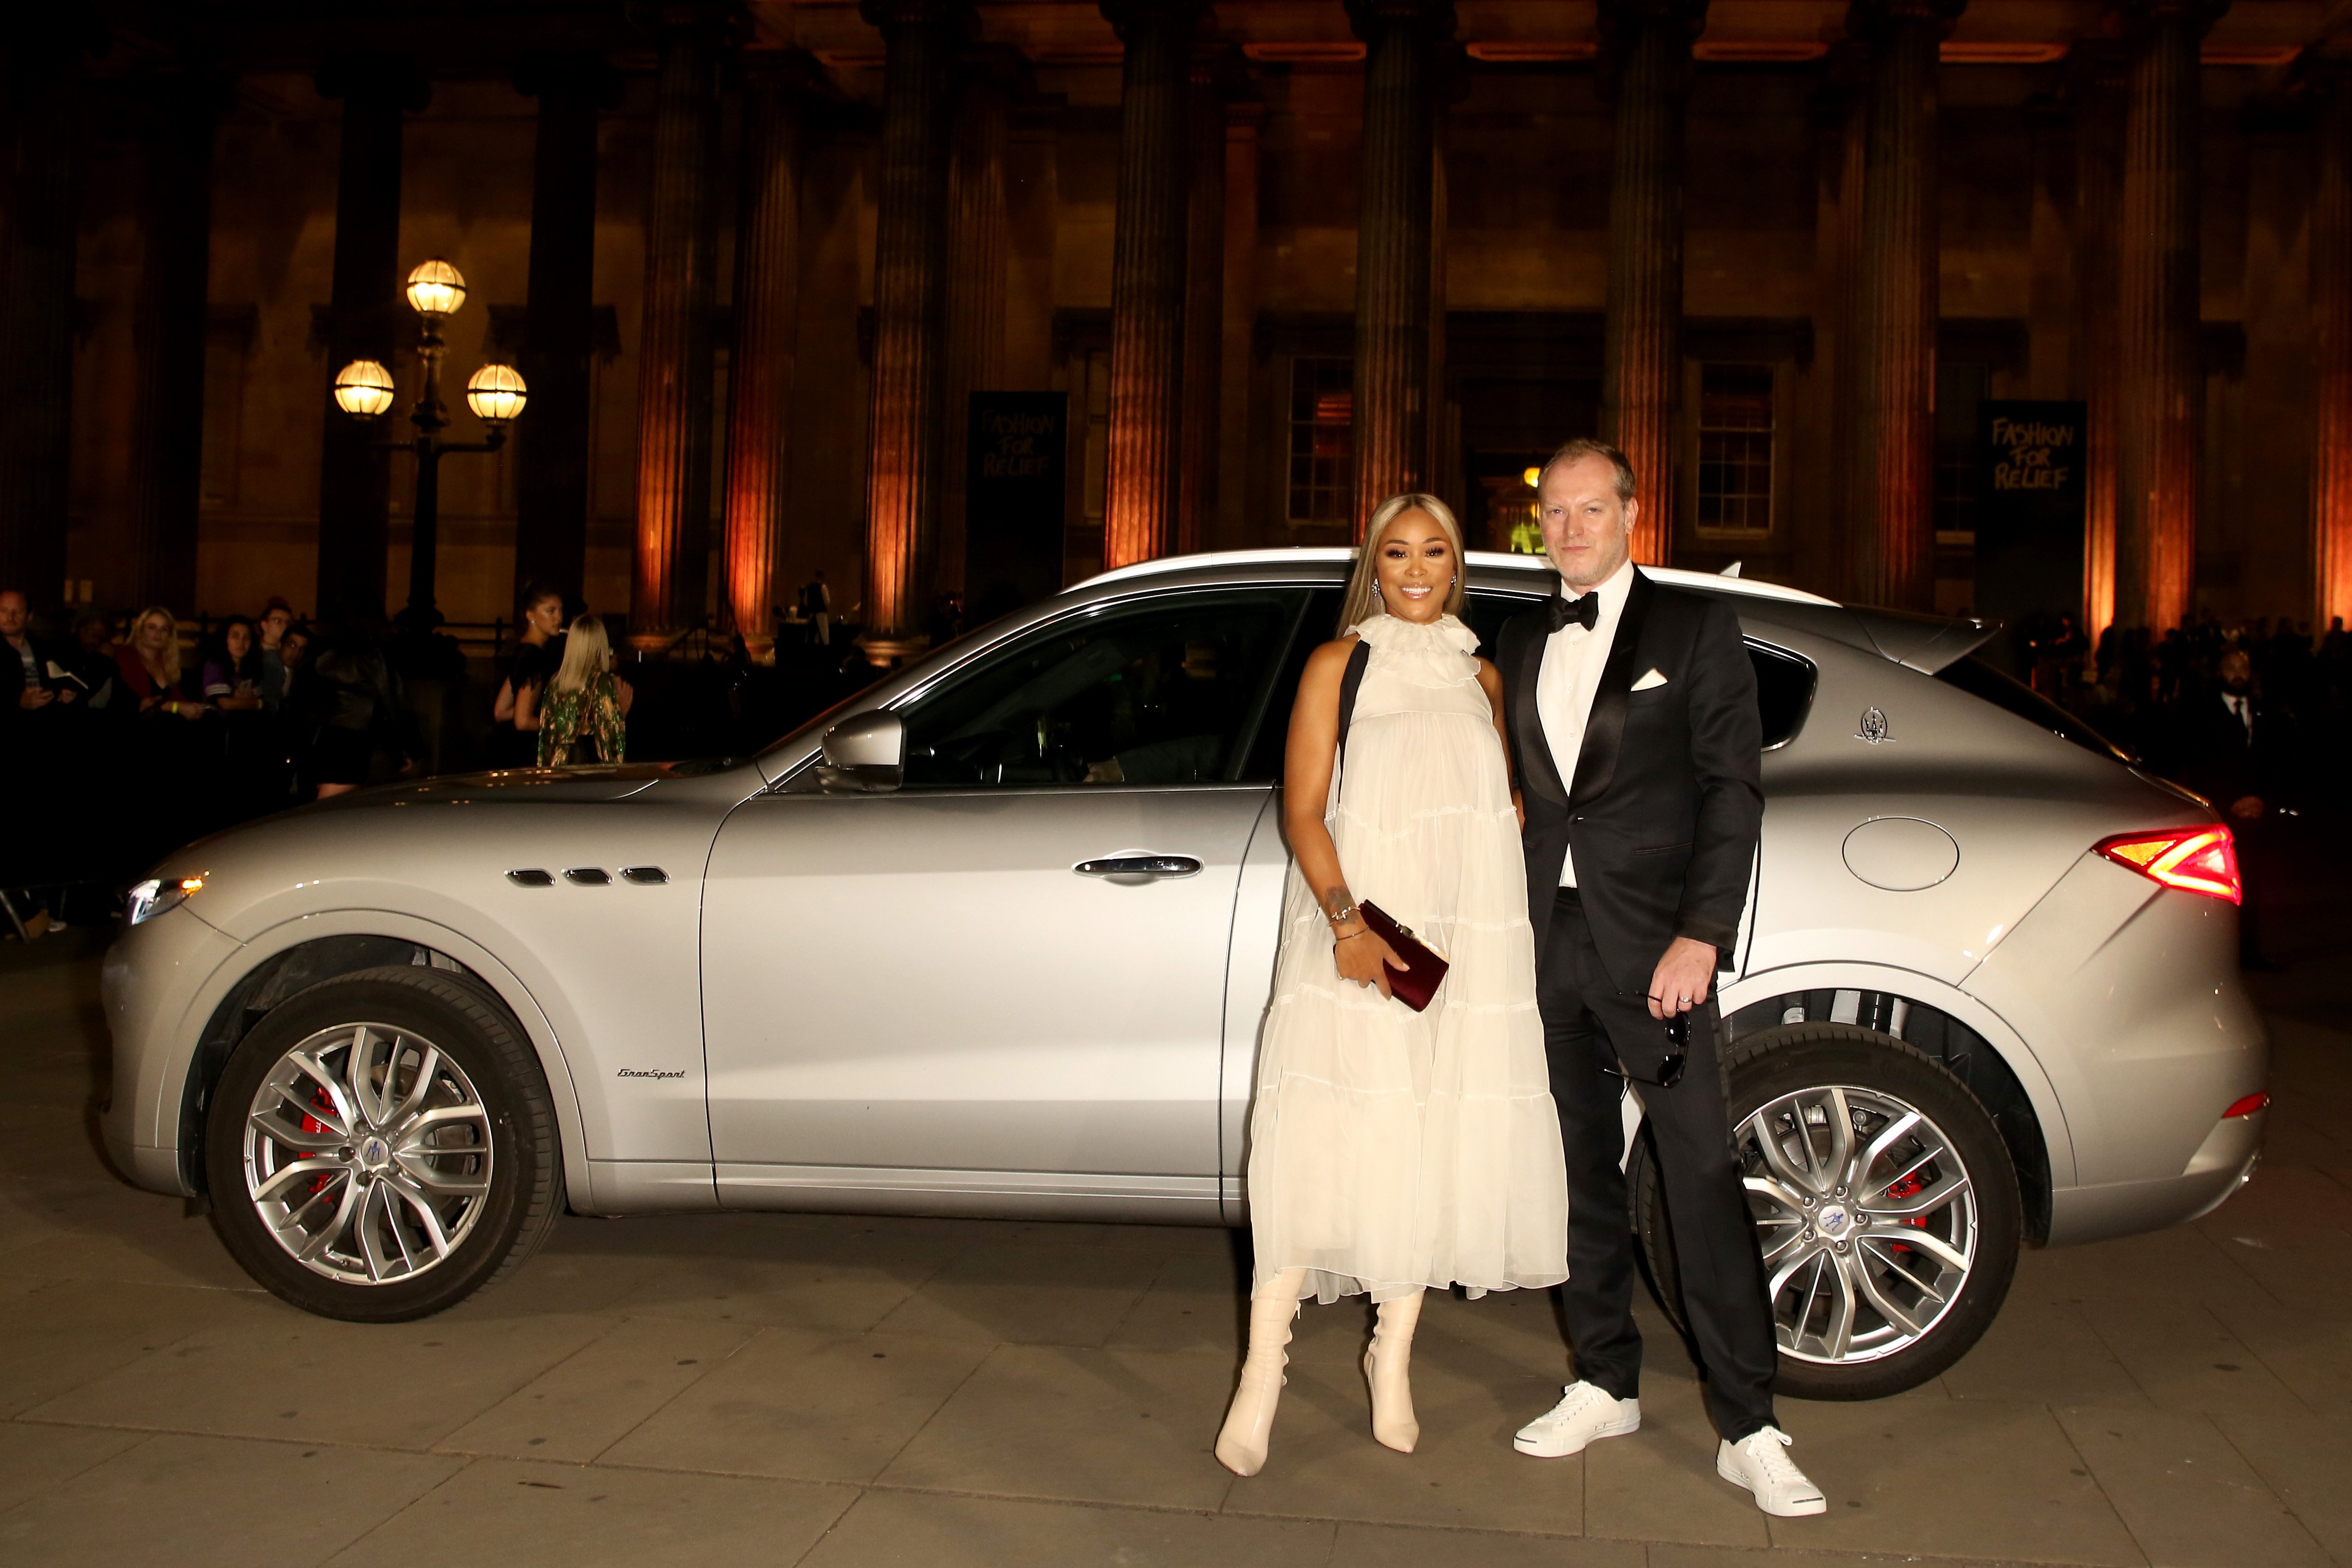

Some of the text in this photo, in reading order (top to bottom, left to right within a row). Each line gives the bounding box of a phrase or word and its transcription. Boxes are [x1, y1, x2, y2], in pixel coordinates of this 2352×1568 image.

[981, 408, 1056, 436] FASHION
[1992, 416, 2074, 446] FASHION
[997, 435, 1034, 455] FOR
[2009, 445, 2051, 467] FOR
[983, 451, 1050, 478] RELIEF
[1993, 461, 2070, 491] RELIEF
[618, 1068, 685, 1080] GranSport
